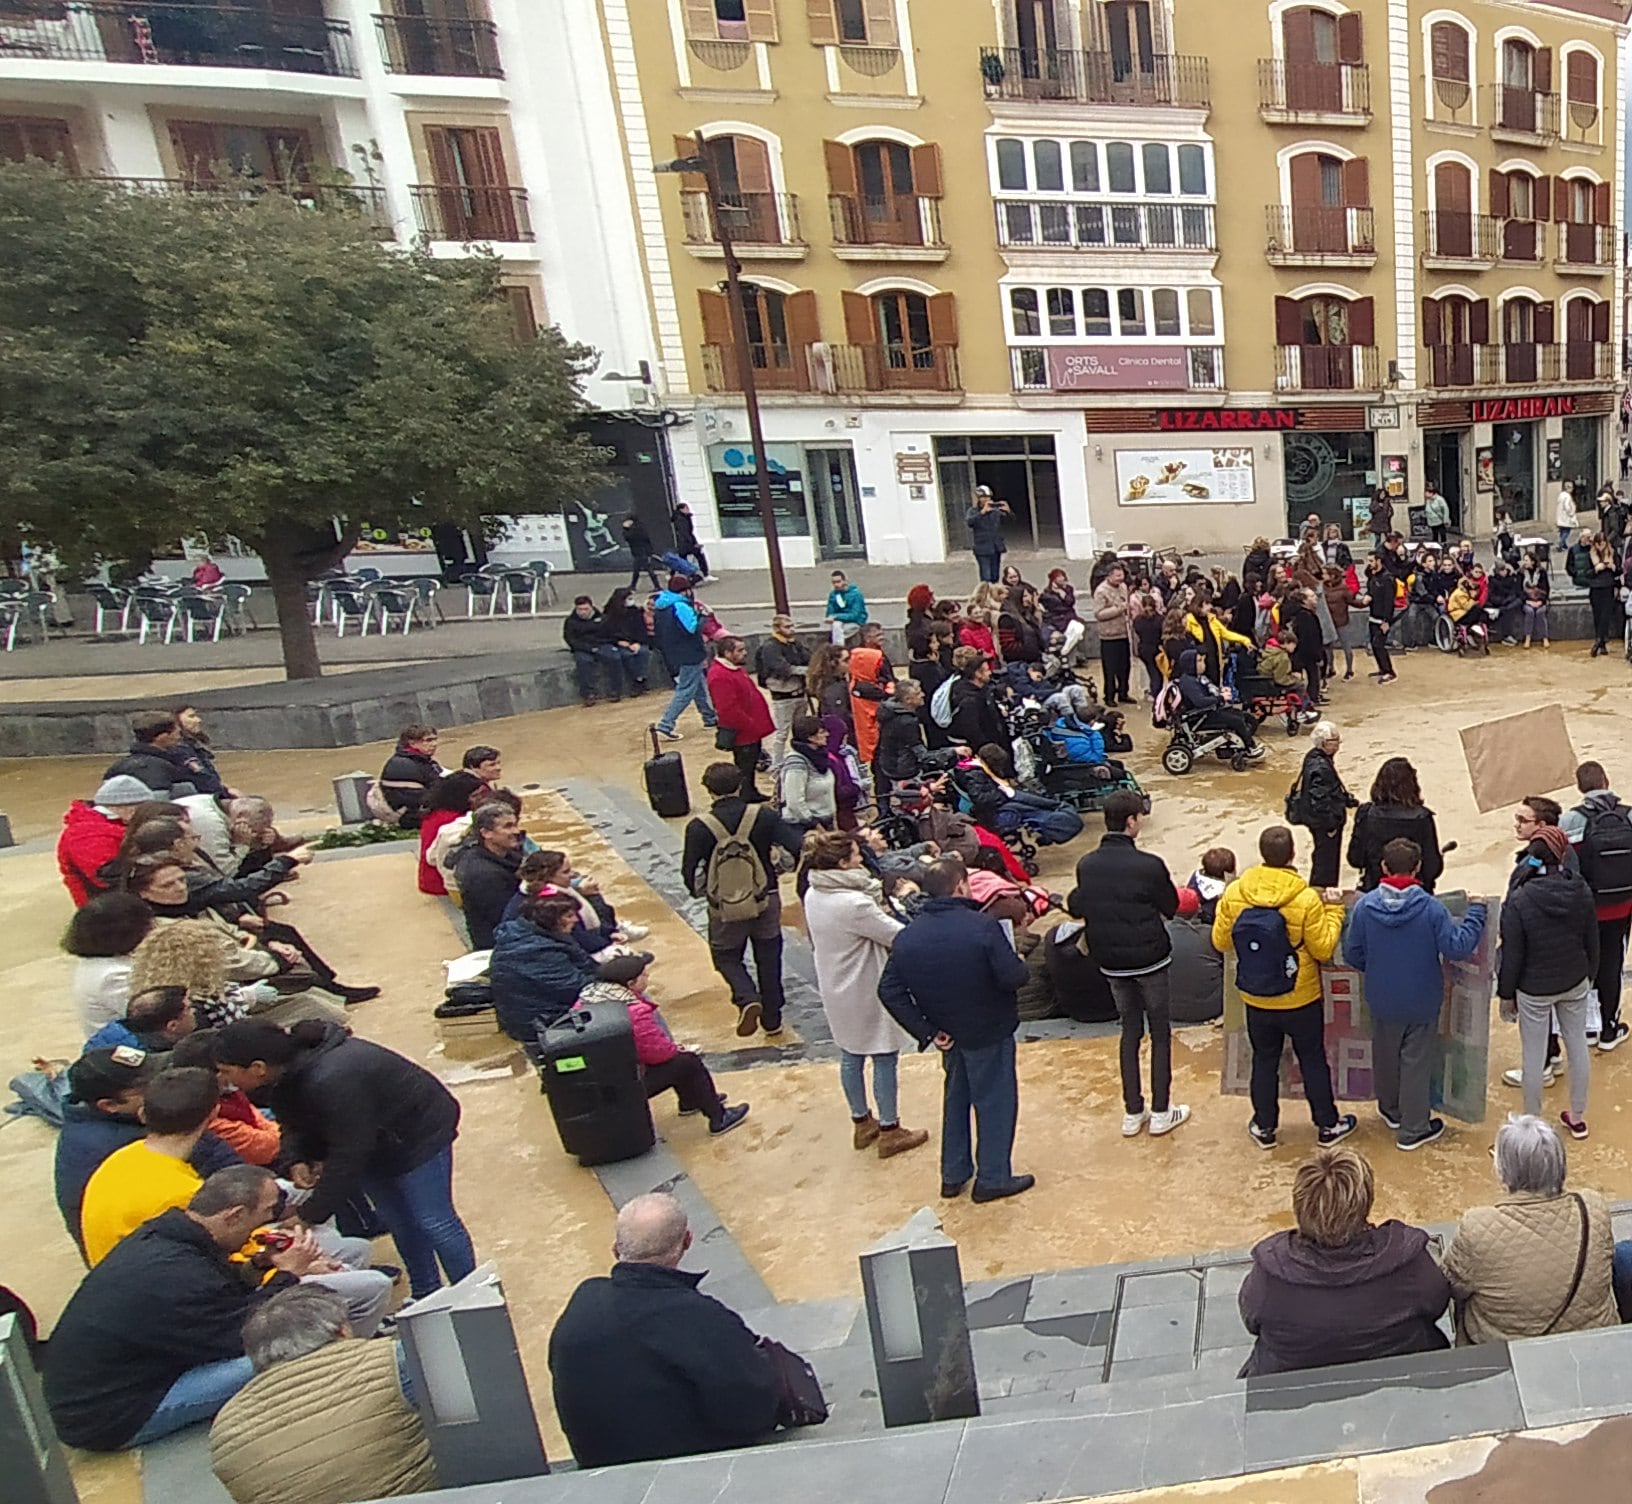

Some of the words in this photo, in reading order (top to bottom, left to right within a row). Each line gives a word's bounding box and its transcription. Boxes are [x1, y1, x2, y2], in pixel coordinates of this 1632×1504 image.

[1065, 356, 1099, 366] ORTS
[1150, 357, 1182, 366] Dental
[1472, 396, 1576, 422] LIZARRAN
[1160, 409, 1295, 429] LIZARRAN
